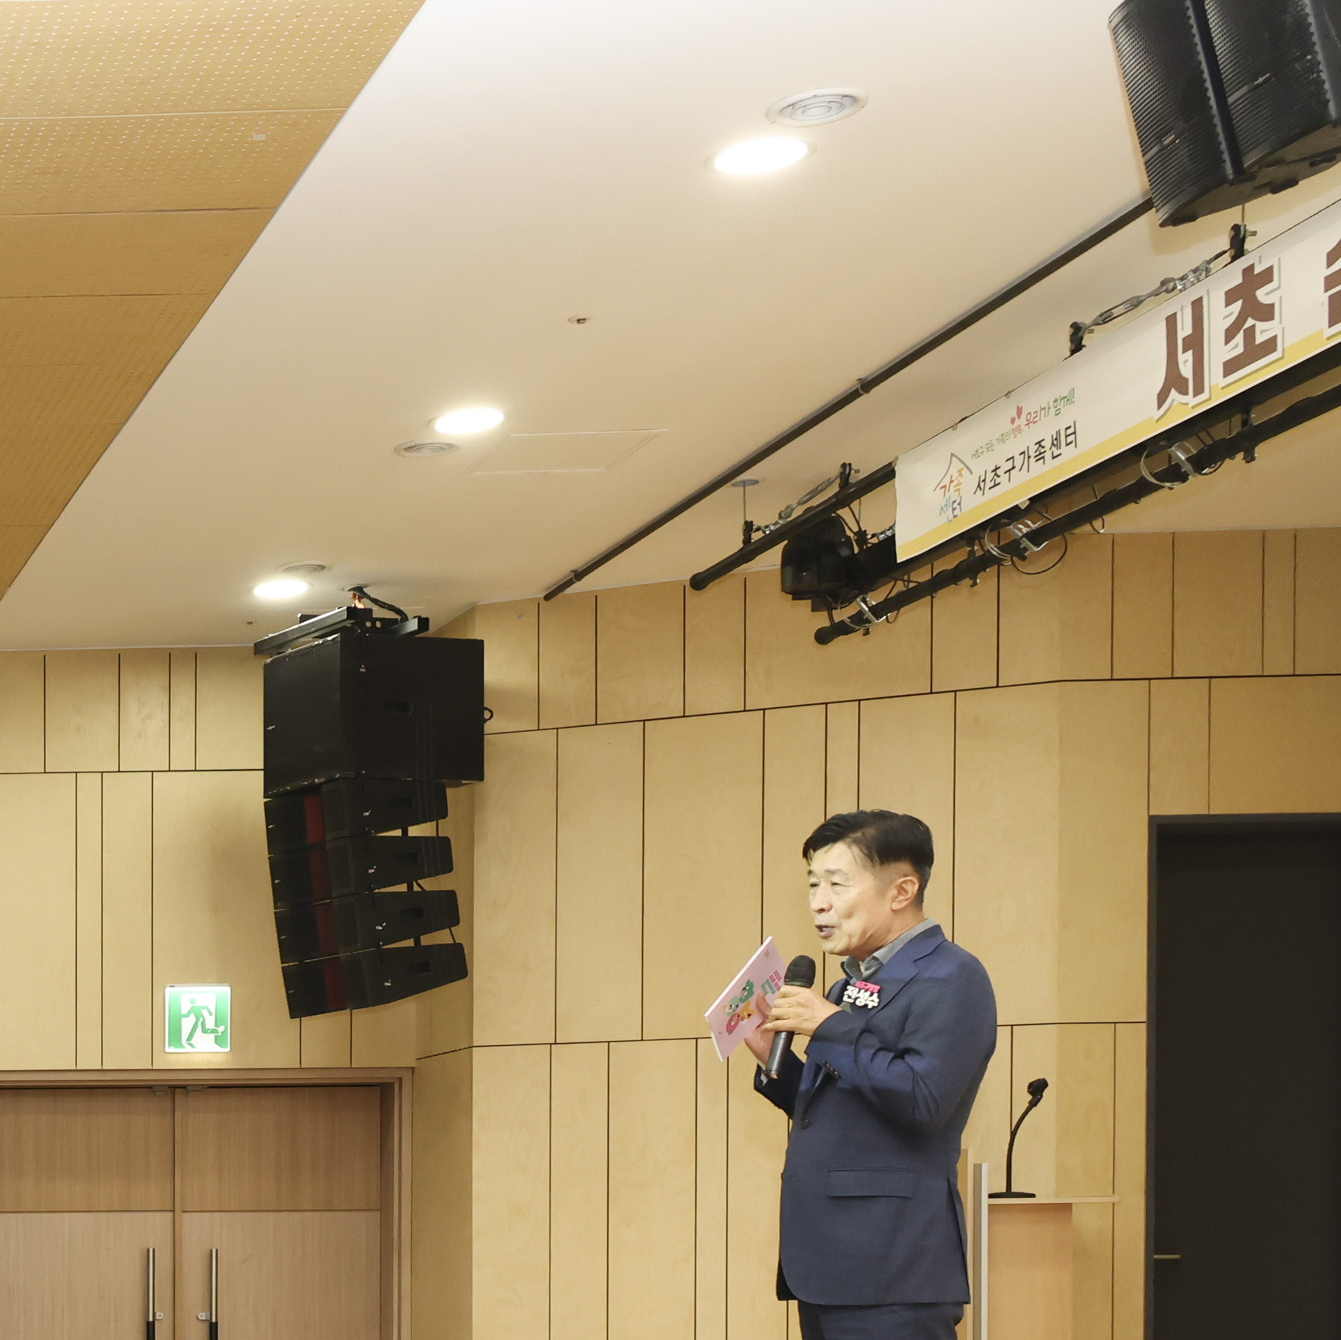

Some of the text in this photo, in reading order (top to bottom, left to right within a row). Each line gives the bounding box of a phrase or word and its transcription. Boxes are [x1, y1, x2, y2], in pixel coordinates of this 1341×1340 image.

[1157, 260, 1279, 413] 서초
[940, 467, 964, 498] 가족
[973, 421, 1077, 496] 서초구가족센터
[843, 985, 880, 1009] 전성수
